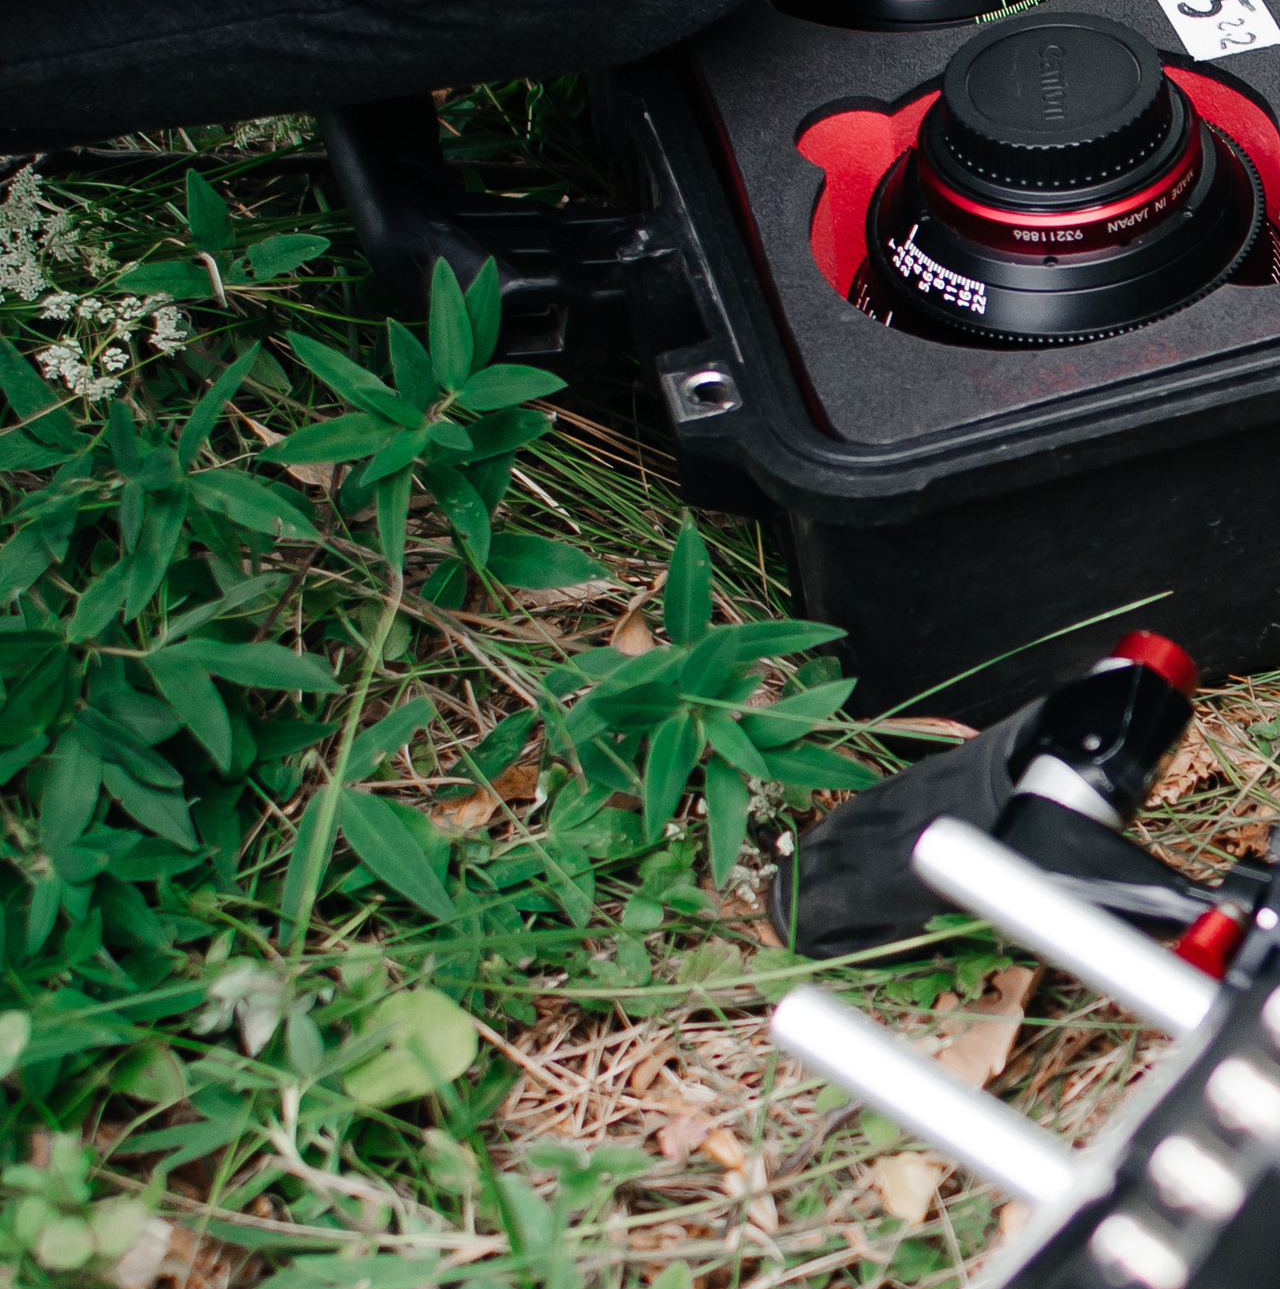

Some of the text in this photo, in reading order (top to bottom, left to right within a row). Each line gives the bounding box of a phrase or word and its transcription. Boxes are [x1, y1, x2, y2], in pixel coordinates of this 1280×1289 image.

[1039, 44, 1065, 121] Canon
[1012, 168, 1195, 243] MADE IN JAPAN 93211886
[912, 263, 923, 276] 4
[918, 270, 934, 293] 5.6
[932, 277, 946, 290] 8
[943, 285, 958, 302] 11
[956, 289, 972, 307] 16
[970, 294, 987, 315] 22
